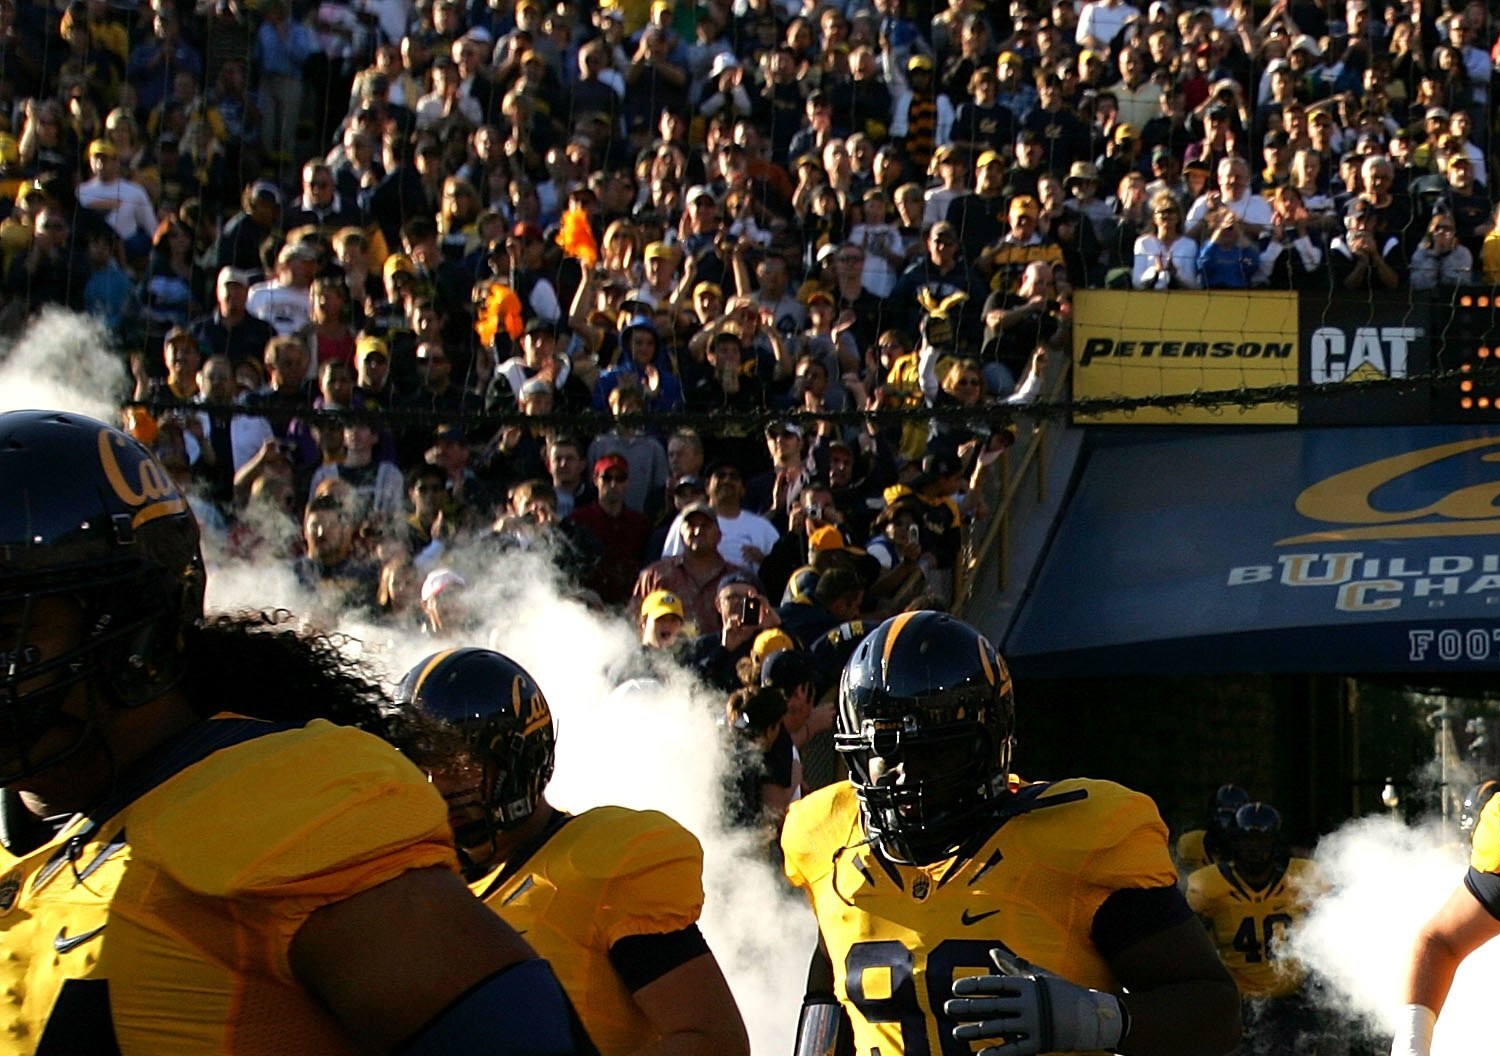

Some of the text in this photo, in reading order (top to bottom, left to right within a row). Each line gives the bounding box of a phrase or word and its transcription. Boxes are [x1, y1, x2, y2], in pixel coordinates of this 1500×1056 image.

[1080, 337, 1293, 366] PETERSON
[1310, 327, 1417, 385] CAT
[97, 428, 188, 528] Ca
